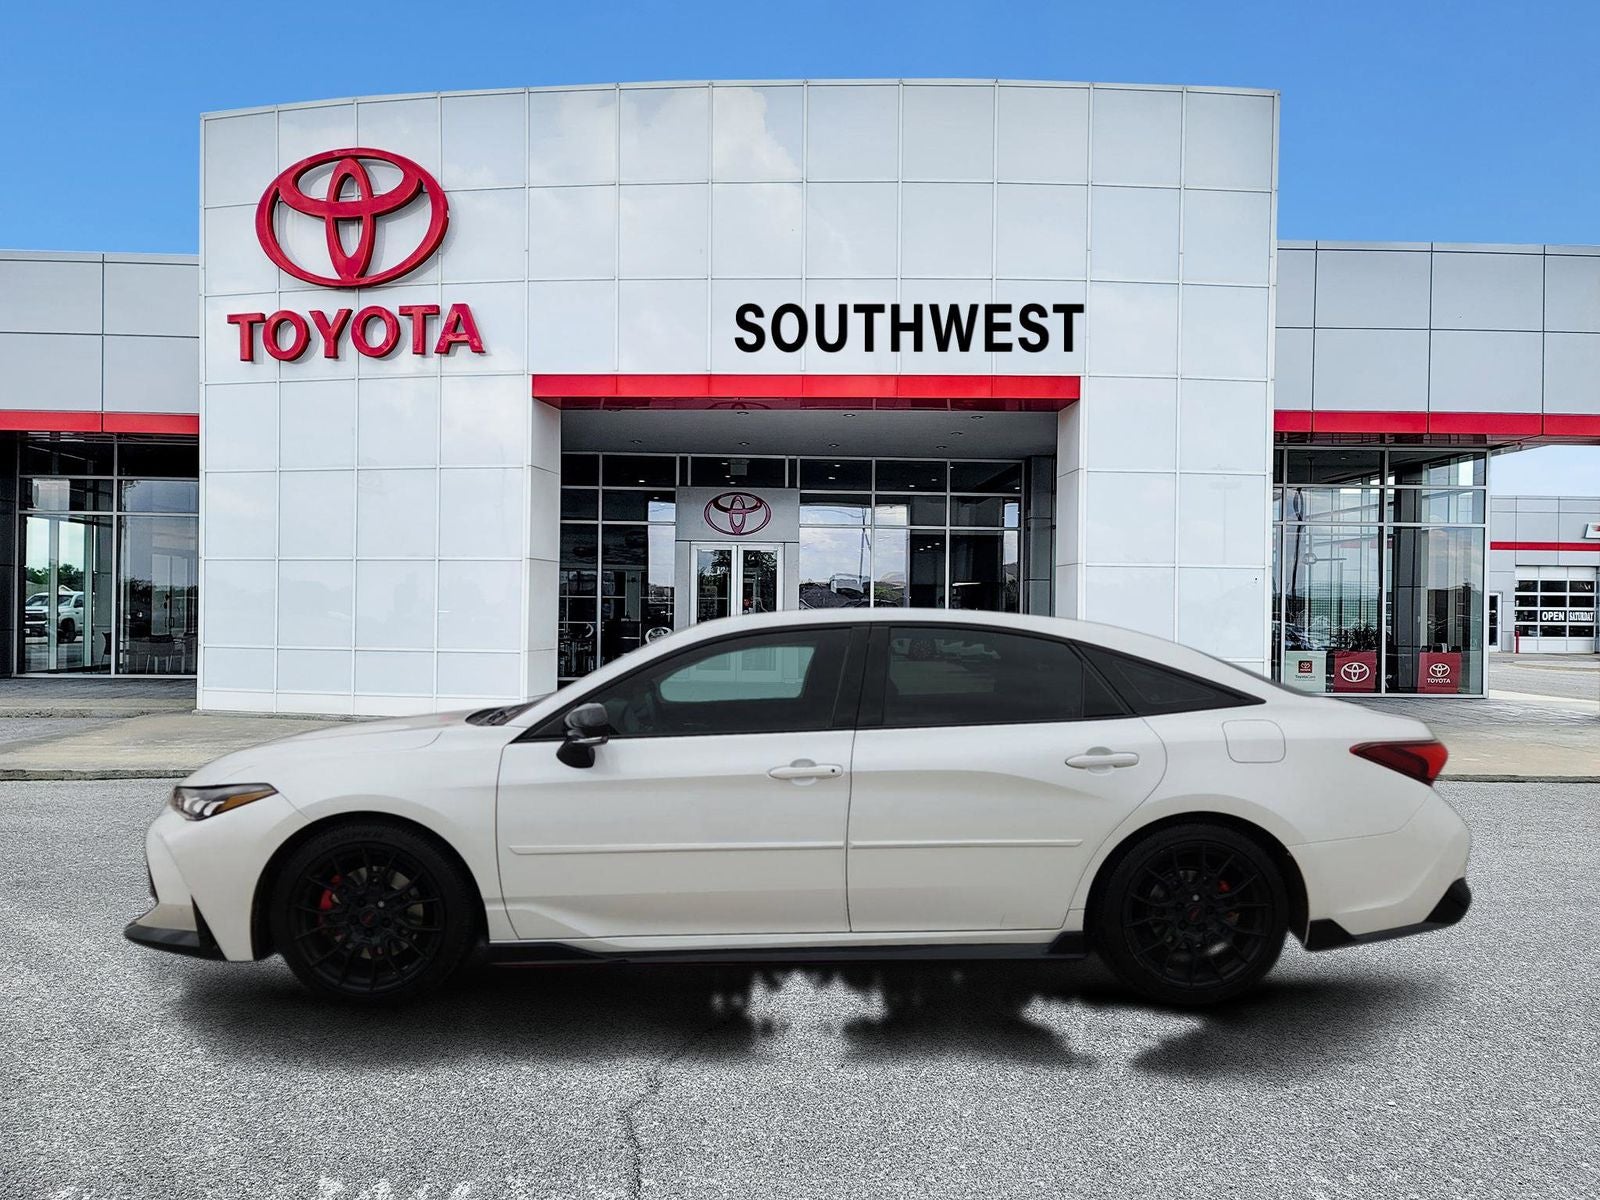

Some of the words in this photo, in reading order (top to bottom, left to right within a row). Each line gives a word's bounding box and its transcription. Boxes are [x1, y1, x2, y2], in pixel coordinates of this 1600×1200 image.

[227, 302, 484, 361] TOYOTA
[735, 303, 1084, 352] SOUTHWEST
[1542, 611, 1565, 621] OPEN
[1569, 611, 1594, 621] SATURDAY
